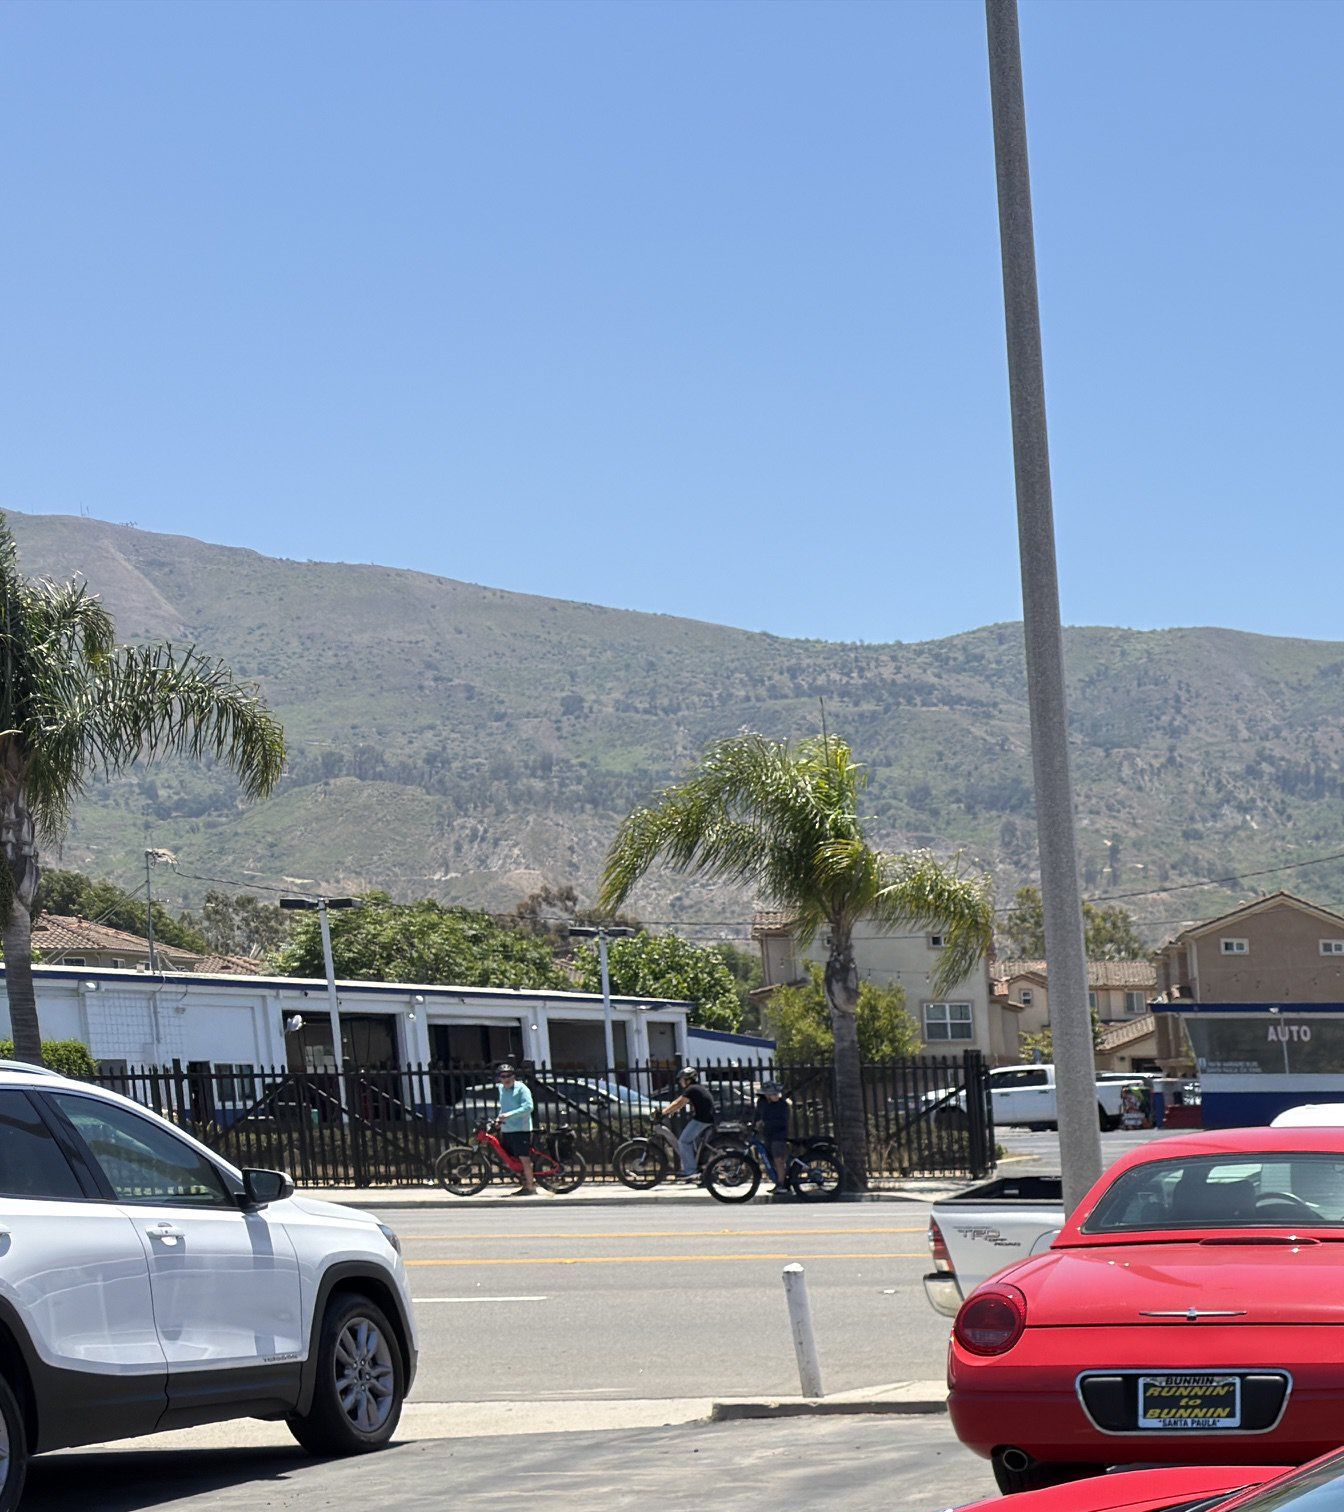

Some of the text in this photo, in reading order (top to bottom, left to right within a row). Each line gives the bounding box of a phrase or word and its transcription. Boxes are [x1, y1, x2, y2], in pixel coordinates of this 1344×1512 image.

[1267, 1026, 1311, 1041] AUTO
[1165, 1377, 1215, 1385] BUNNIN
[1145, 1386, 1235, 1396] RUNNIN'
[1179, 1398, 1201, 1406] to
[1146, 1407, 1231, 1418] BUNNIN
